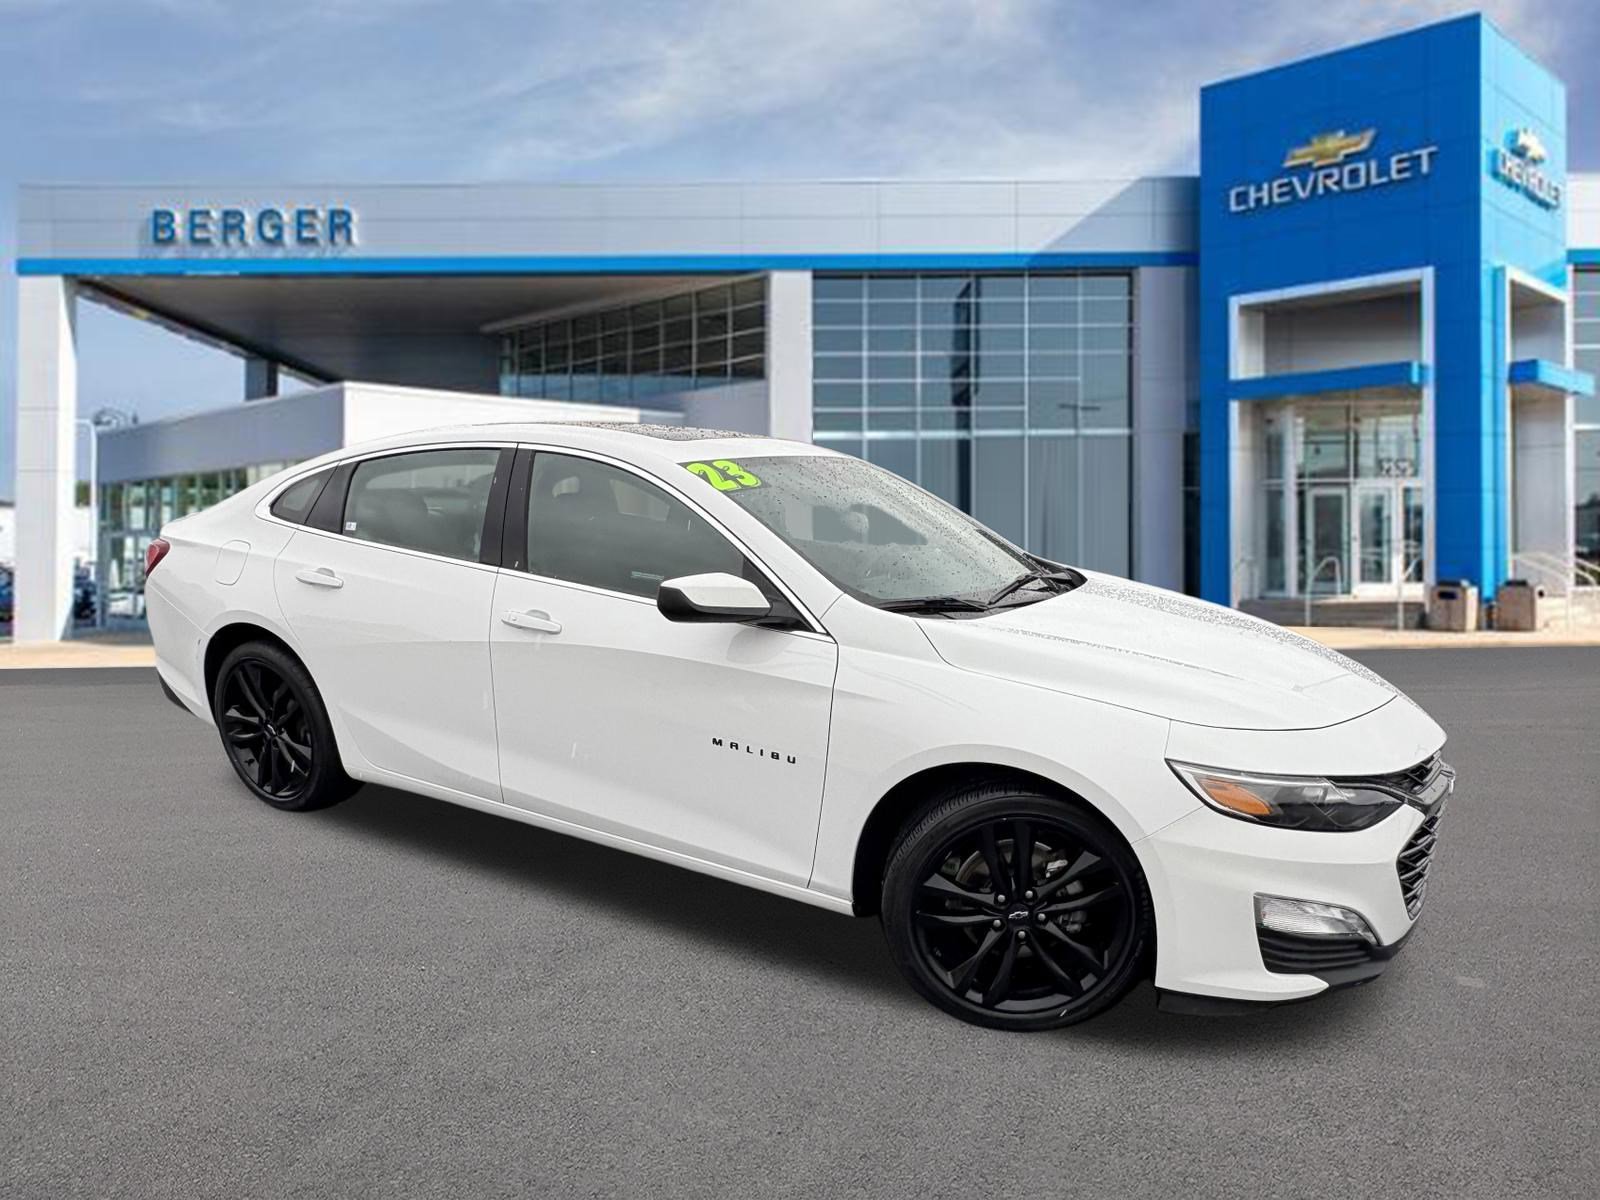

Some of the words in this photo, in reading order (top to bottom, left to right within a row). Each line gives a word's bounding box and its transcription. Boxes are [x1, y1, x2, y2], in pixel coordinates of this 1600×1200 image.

[1229, 145, 1438, 213] CHEVROLET
[151, 208, 357, 245] BERGER
[685, 459, 761, 492] 23
[711, 737, 796, 764] MALIBU
